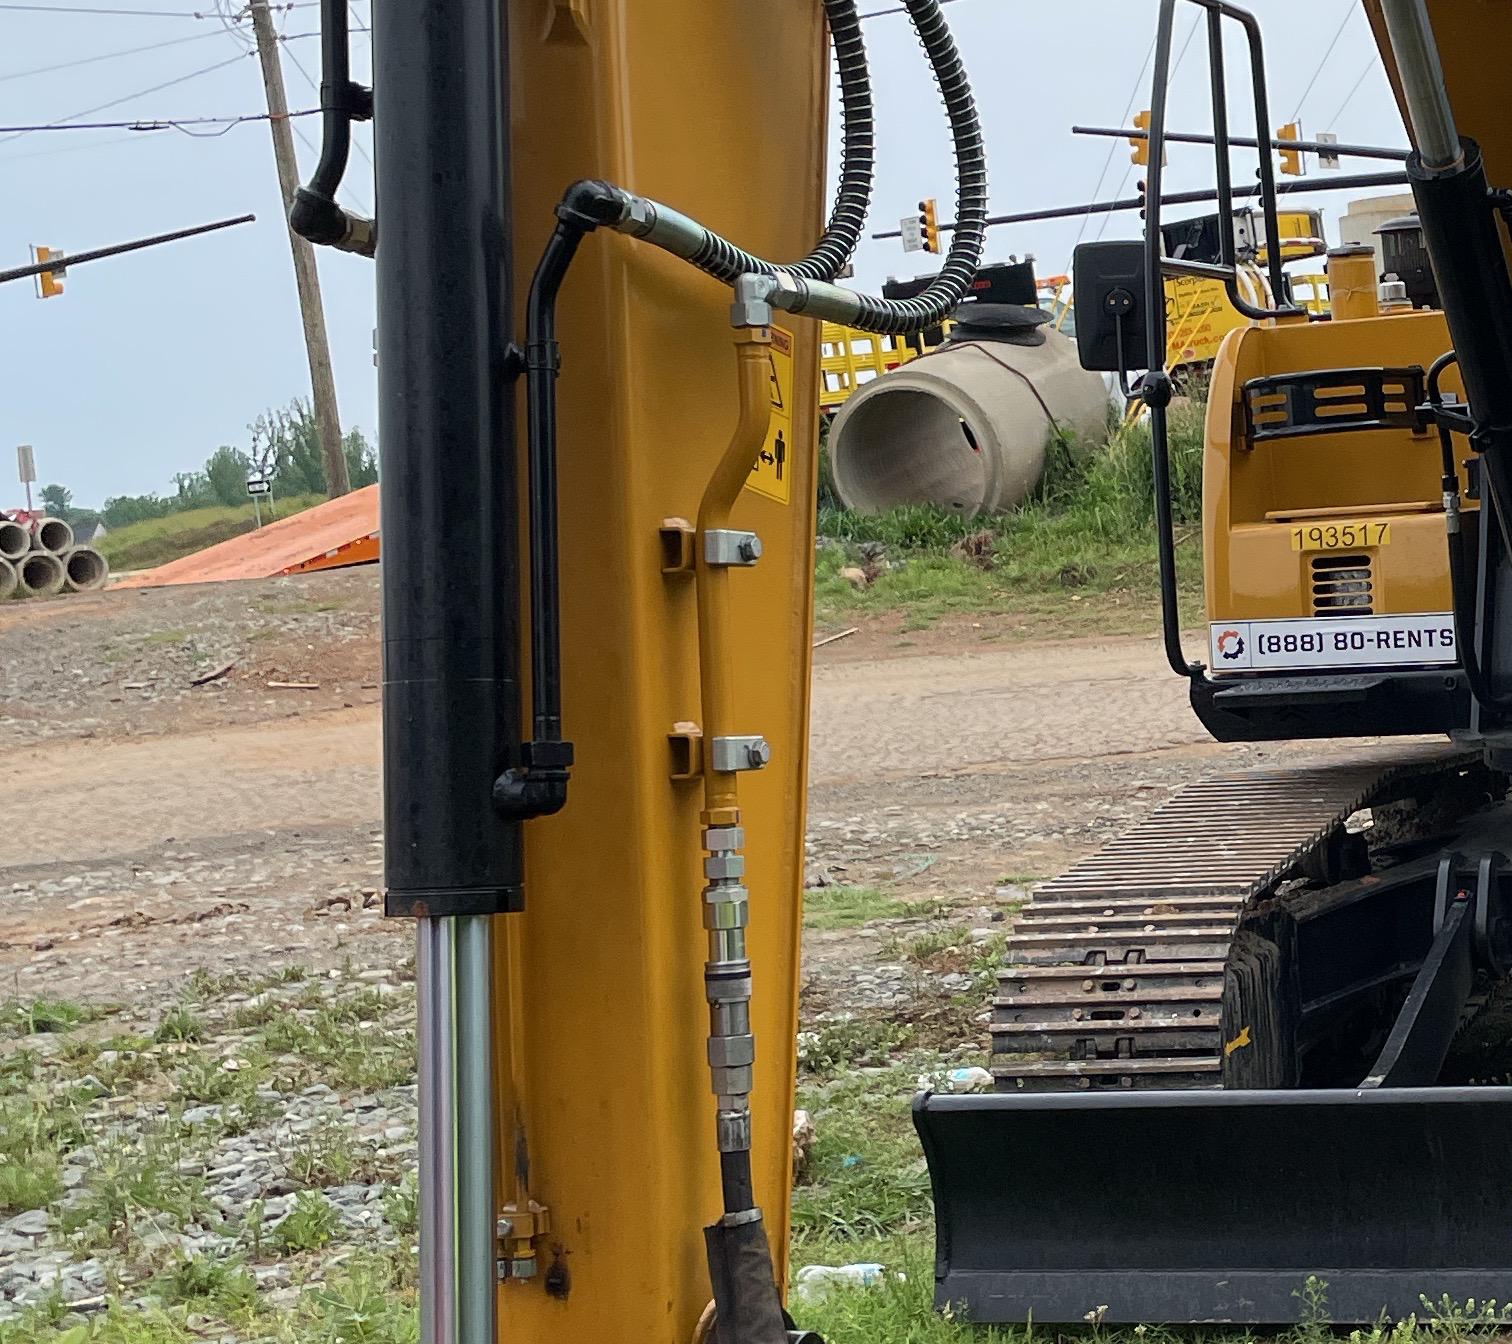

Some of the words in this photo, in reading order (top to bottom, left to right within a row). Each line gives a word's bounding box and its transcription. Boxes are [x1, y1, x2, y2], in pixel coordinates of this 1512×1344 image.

[1293, 523, 1388, 550] 193517
[1258, 631, 1324, 654] (888)
[1334, 628, 1454, 652] 80-RENTS
